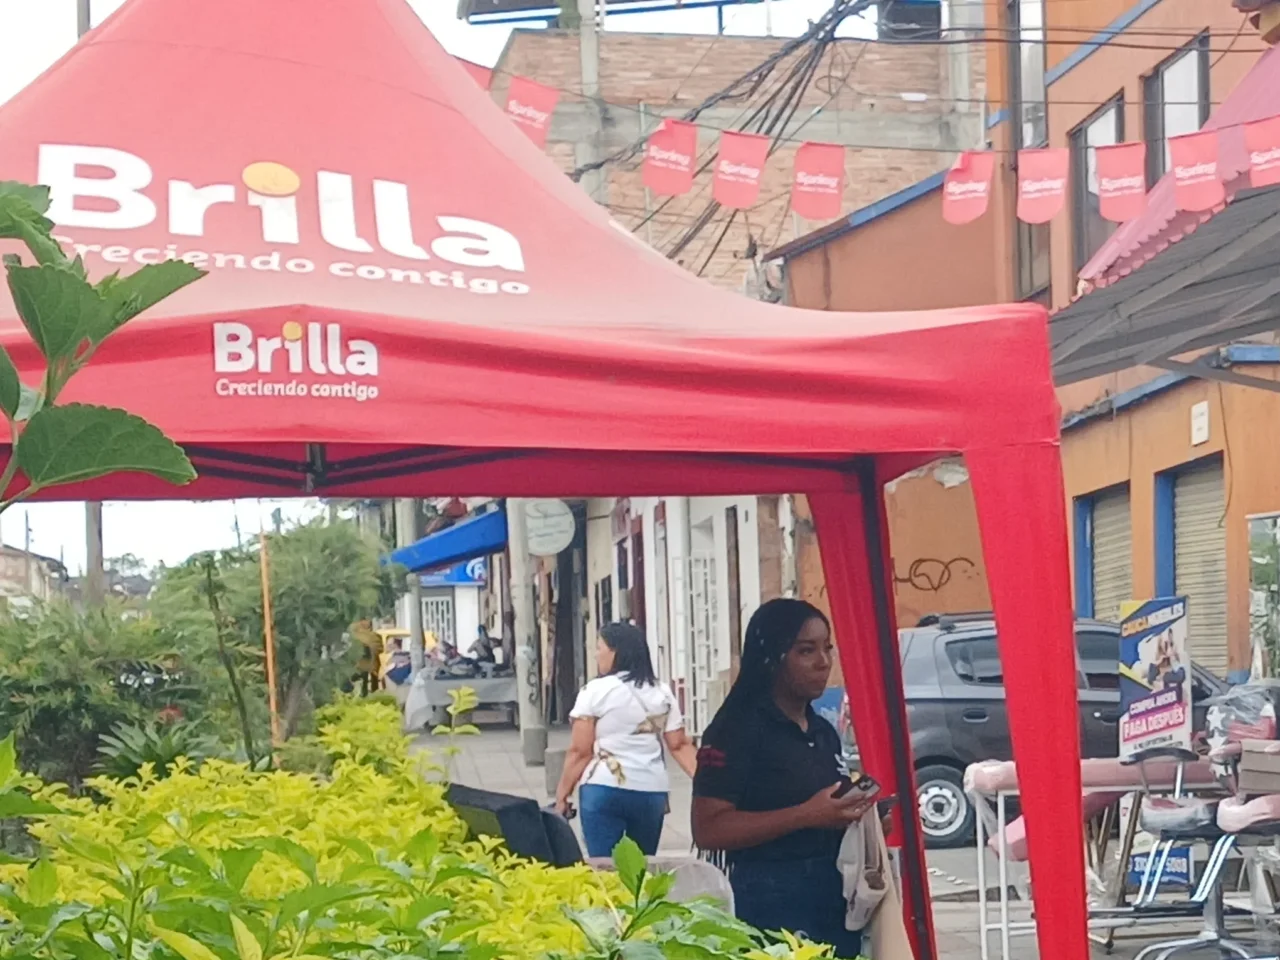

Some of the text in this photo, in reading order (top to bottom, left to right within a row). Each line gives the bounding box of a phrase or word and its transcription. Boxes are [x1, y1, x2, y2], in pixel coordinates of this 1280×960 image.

[37, 143, 525, 272] Brilla
[51, 234, 530, 294] reciendo contigo
[213, 321, 379, 376] Brilla
[216, 378, 379, 401] Creciendo contigo
